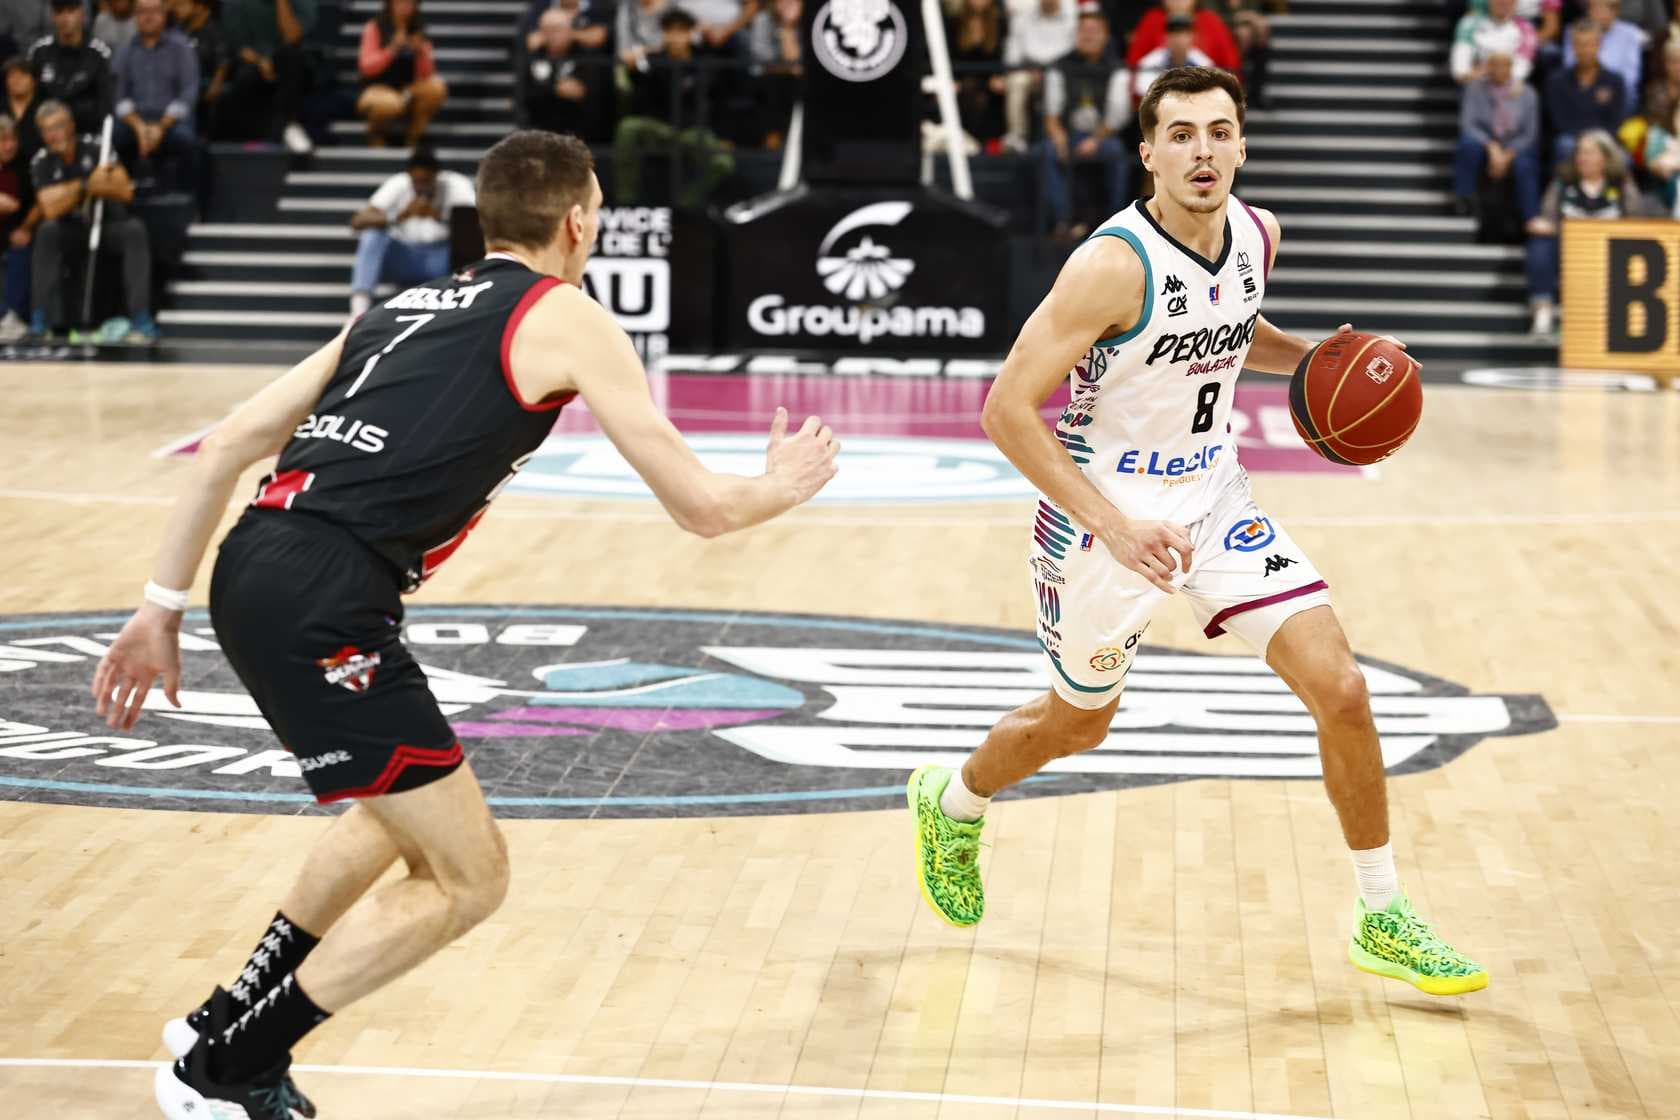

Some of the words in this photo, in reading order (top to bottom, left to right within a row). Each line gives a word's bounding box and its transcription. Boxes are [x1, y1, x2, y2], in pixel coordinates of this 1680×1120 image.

[747, 295, 985, 344] Groupama
[346, 313, 436, 398] 7
[1185, 355, 1238, 377] BOULAZAC
[1192, 382, 1221, 434] 8
